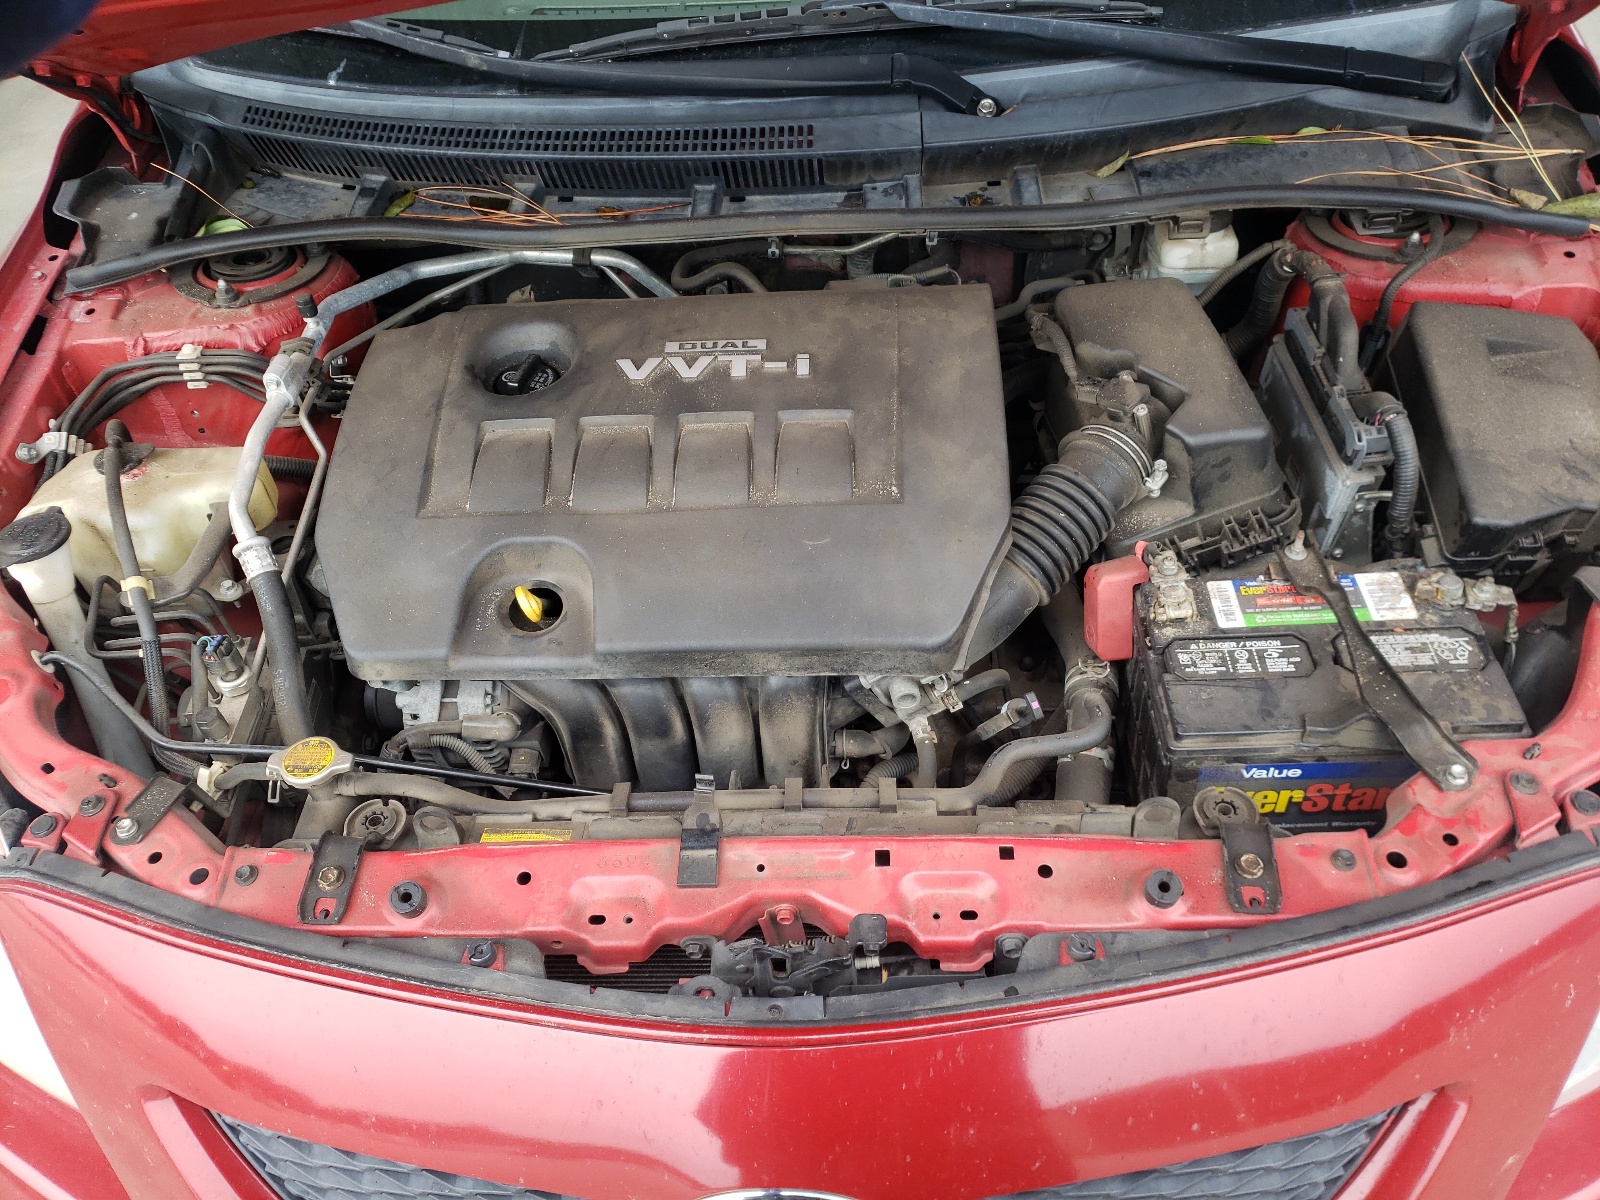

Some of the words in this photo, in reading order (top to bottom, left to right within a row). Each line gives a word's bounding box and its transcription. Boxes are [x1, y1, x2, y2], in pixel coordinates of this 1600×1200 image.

[679, 341, 758, 350] DUAL
[616, 354, 810, 379] VVT-i
[1199, 641, 1237, 649] DANGER
[1241, 767, 1302, 779] Value
[1215, 783, 1397, 814] erStar
